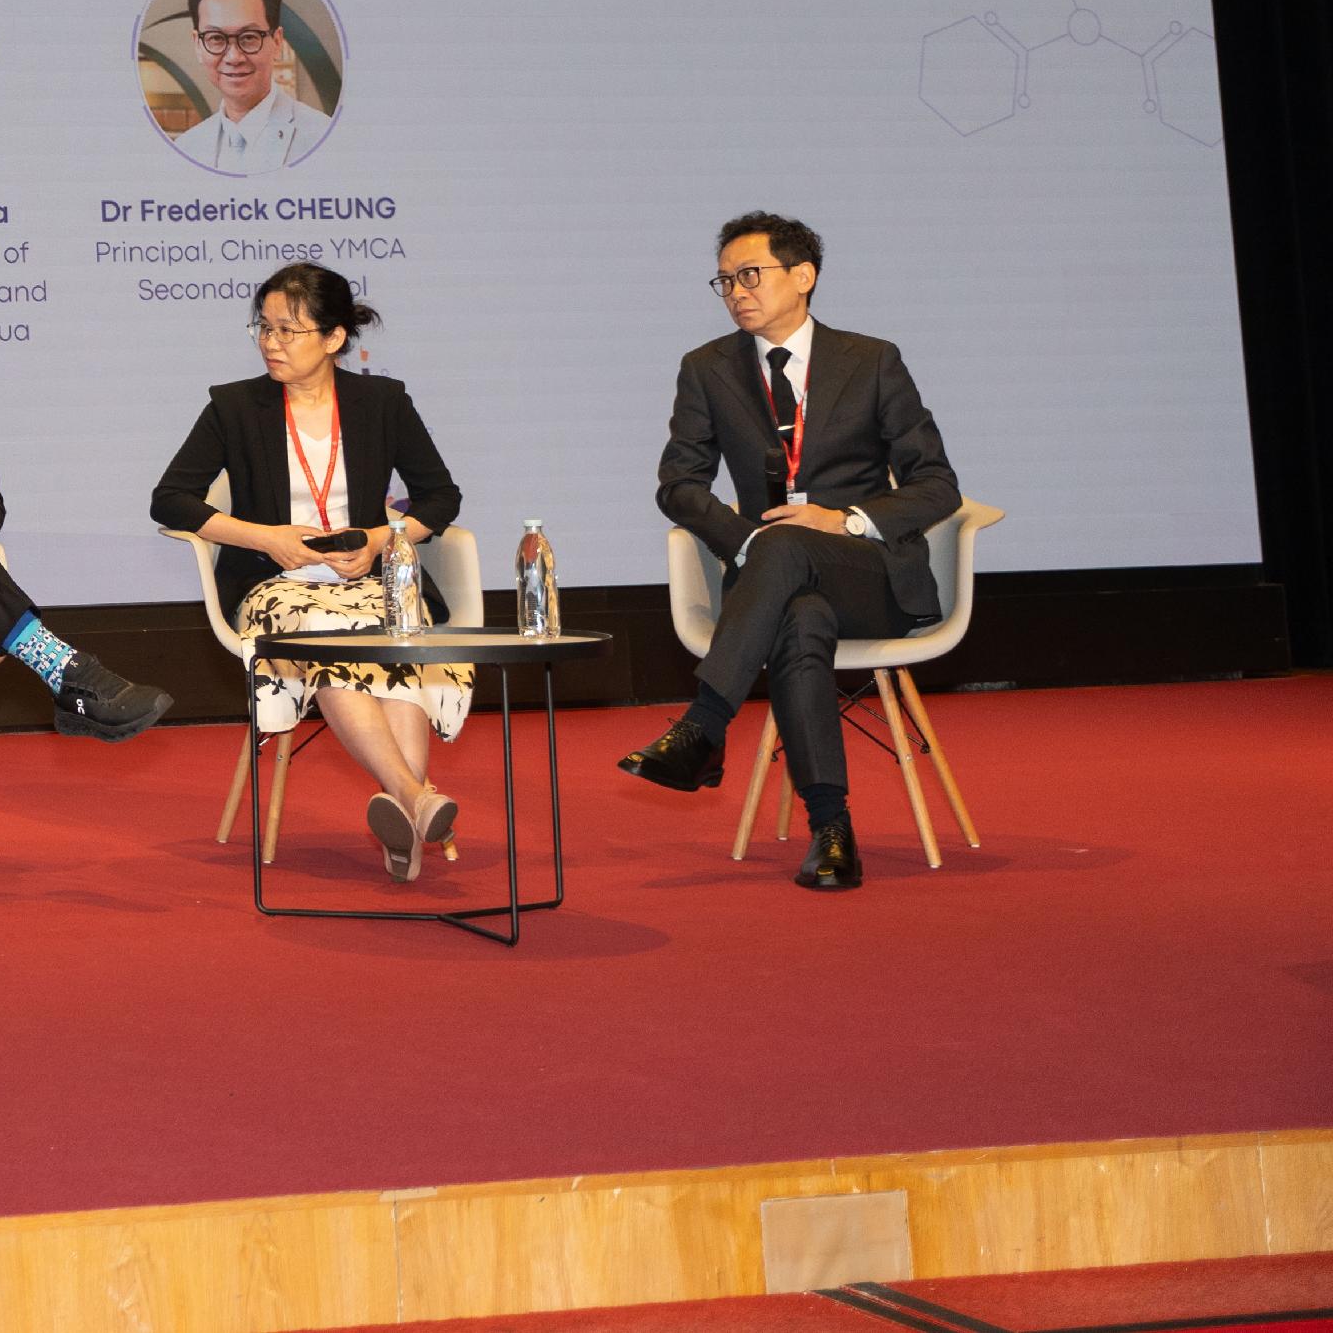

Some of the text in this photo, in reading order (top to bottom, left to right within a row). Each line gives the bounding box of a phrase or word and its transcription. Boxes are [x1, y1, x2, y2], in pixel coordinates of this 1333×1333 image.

[101, 197, 396, 222] Dr Frederick CHEUNG
[4, 242, 29, 264] of
[96, 238, 406, 266] Principal, Chinese YMCA
